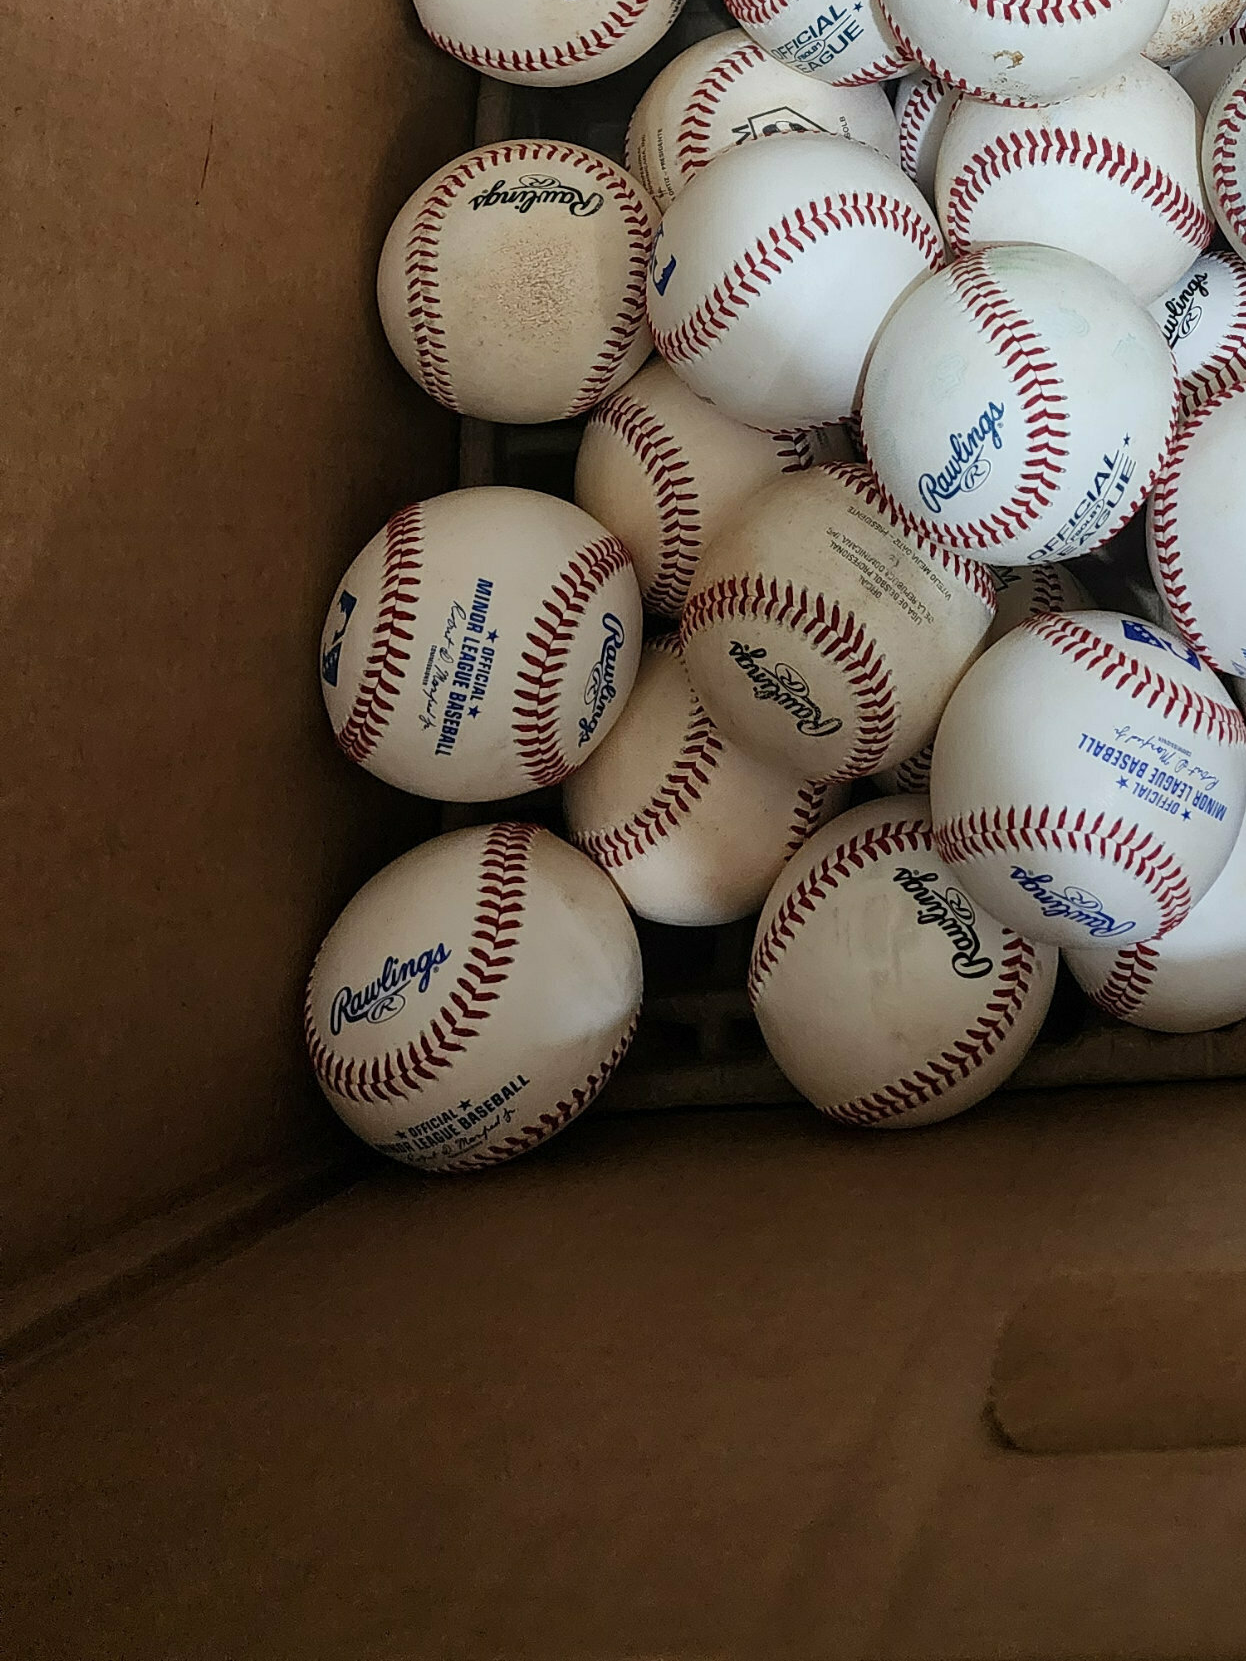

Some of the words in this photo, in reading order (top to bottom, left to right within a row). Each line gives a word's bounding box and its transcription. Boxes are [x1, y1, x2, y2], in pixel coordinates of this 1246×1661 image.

[771, 5, 847, 60] OFFICIAL
[795, 20, 865, 74] EAGUE
[656, 128, 667, 171] PRESIDENTE
[468, 179, 605, 217] Rawlings
[919, 401, 1004, 514] Rawlings
[846, 506, 890, 537] PRESIDENTE
[1027, 449, 1120, 561] OFFICIAL
[1058, 454, 1137, 557] EAGUE
[830, 539, 874, 577] PROFESIONAL
[466, 577, 494, 634] MINOR
[907, 608, 923, 626] LIGA
[452, 635, 481, 690] LEAGUE
[469, 644, 495, 703] OFFICIAL
[578, 612, 625, 748] Rawlings
[729, 641, 843, 737] Rawlings
[434, 691, 467, 756] BASEBALL
[1078, 732, 1150, 779] BASEBALL
[1132, 781, 1181, 815] OFFICIAL
[1148, 767, 1193, 802] LEAGUE
[1192, 790, 1228, 822] MINOR
[893, 867, 994, 979] Rawlings
[1009, 865, 1137, 938] Rawlings
[330, 942, 452, 1036] Rawlings
[407, 1108, 459, 1138] OFFICIAL
[412, 1123, 461, 1151] LEAGUE
[457, 1074, 531, 1130] BASEBALL
